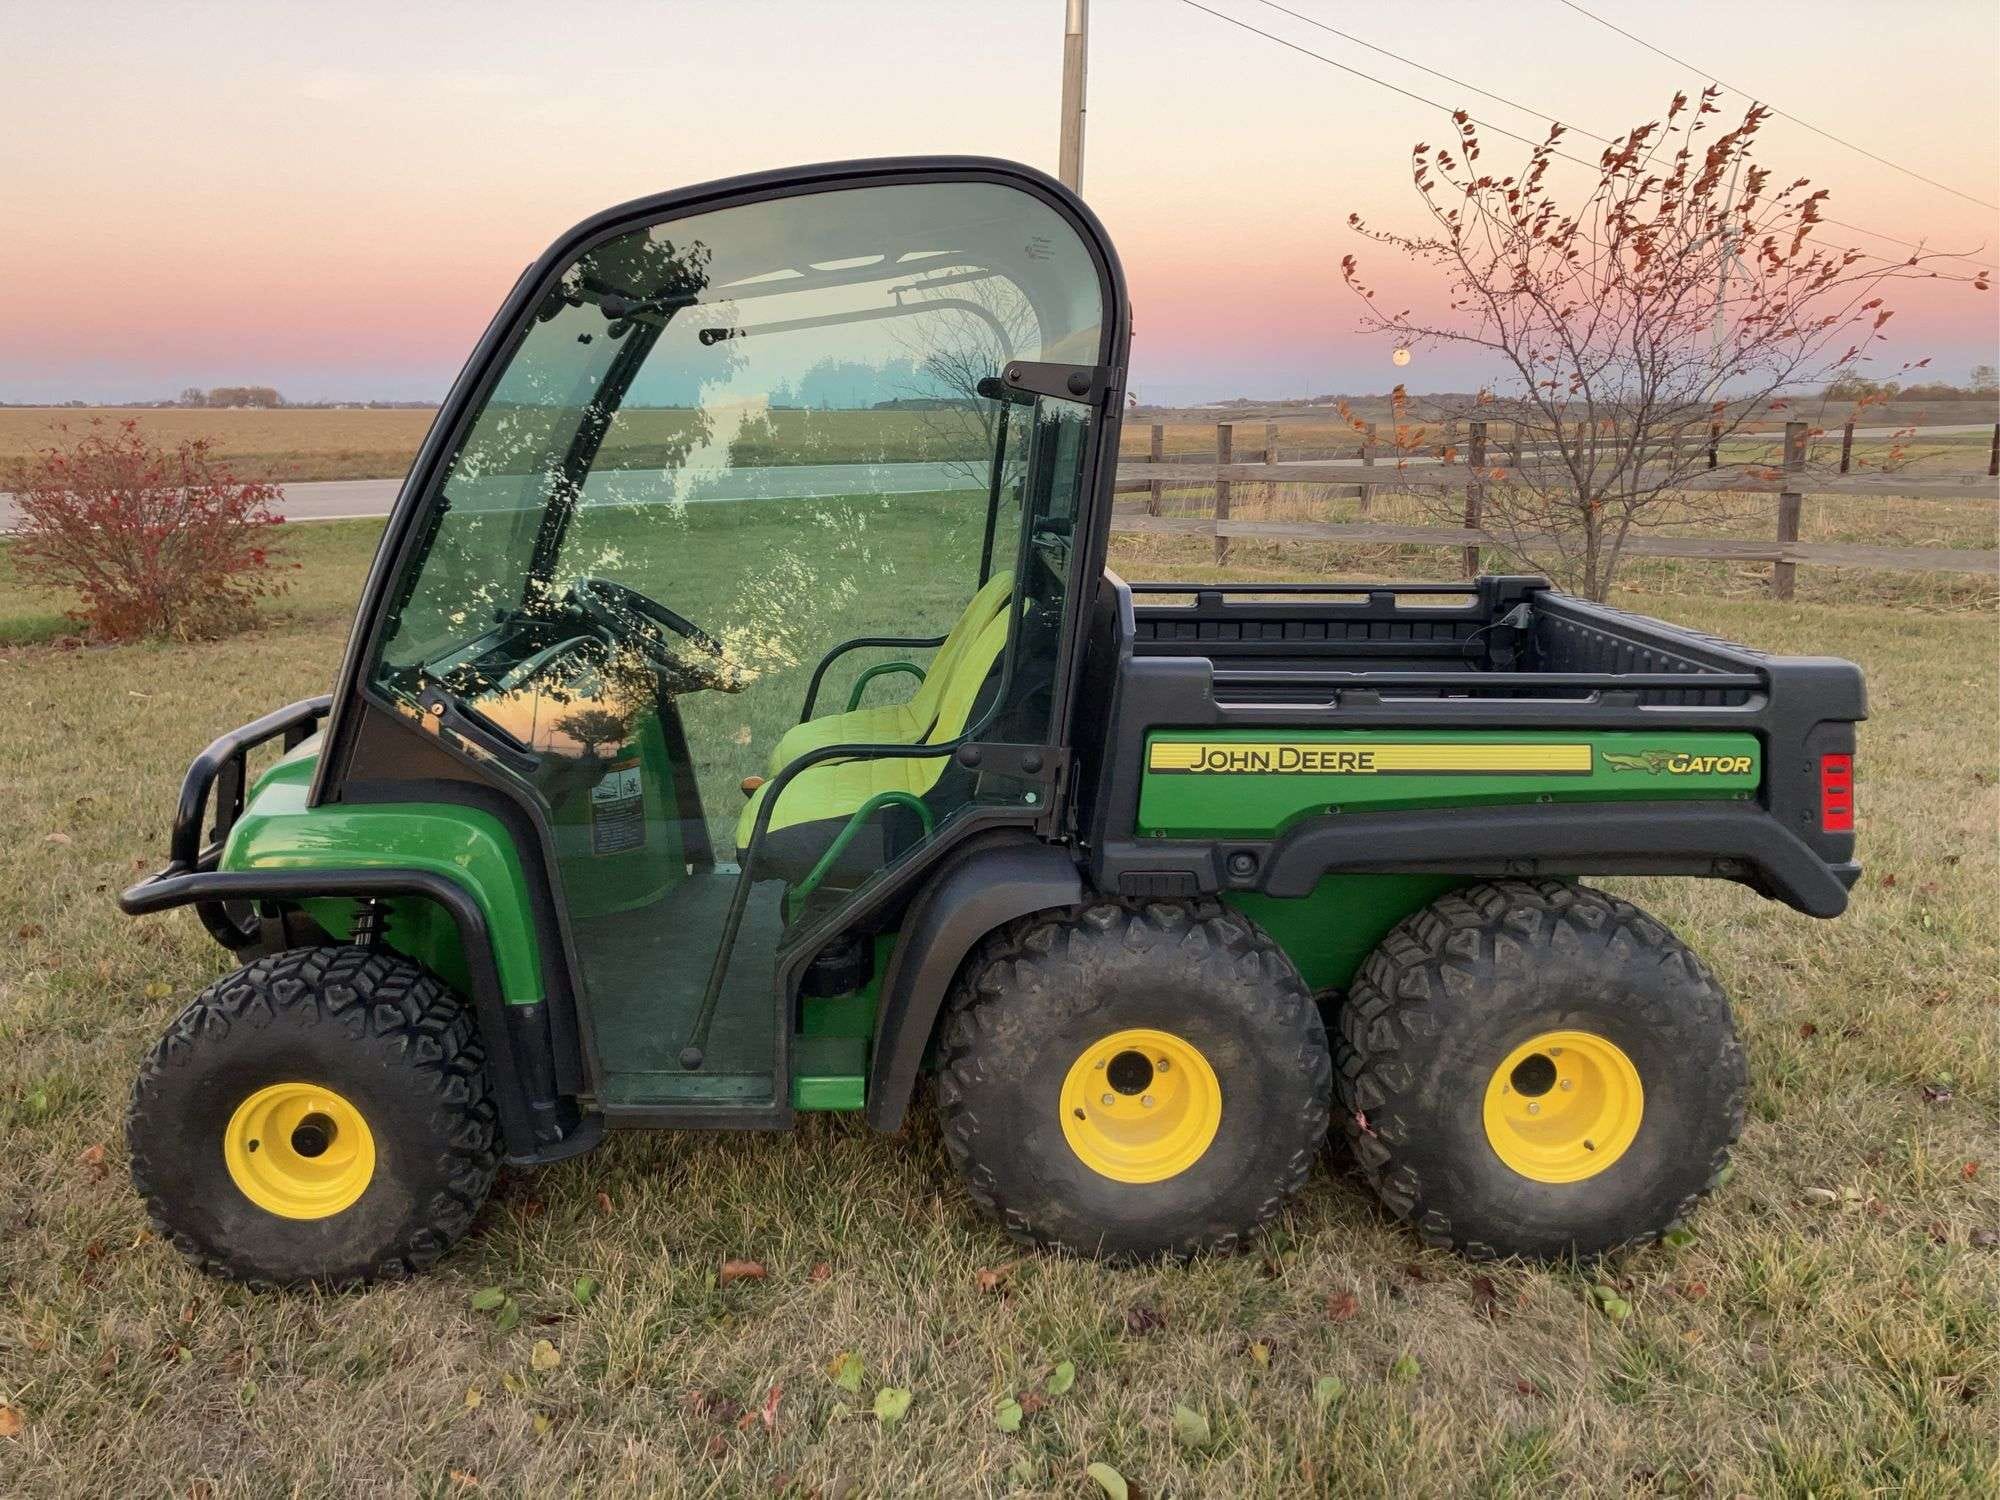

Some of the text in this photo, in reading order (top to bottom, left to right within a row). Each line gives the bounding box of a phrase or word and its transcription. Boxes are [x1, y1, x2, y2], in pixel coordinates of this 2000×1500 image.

[1190, 746, 1375, 770] JOHN DEERE
[1667, 753, 1752, 774] GATOR
